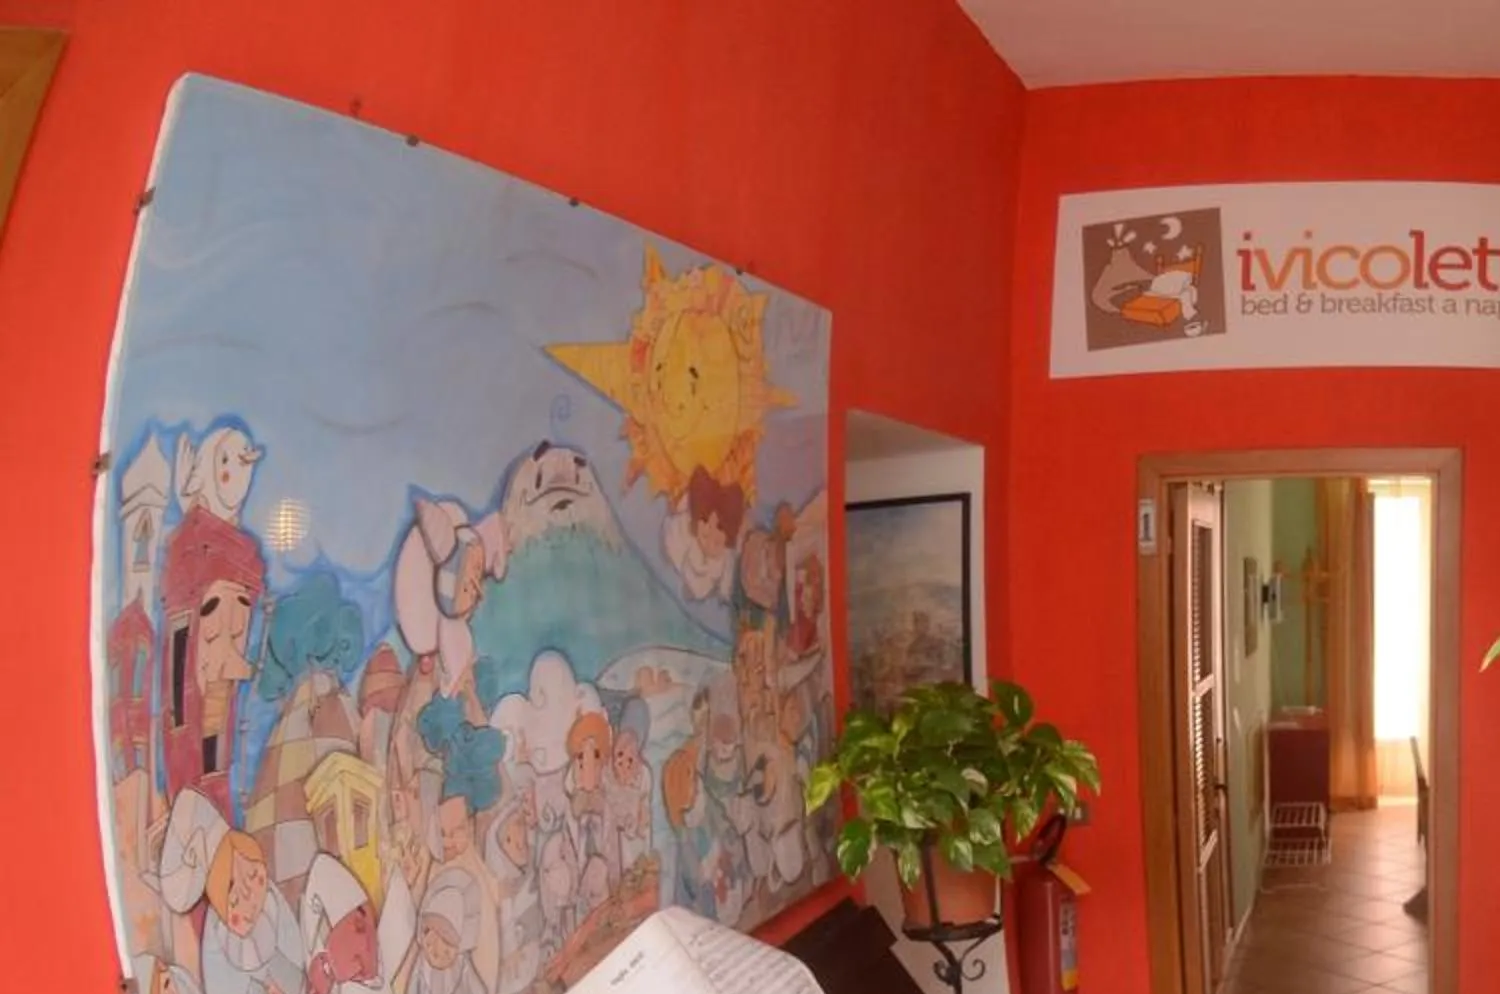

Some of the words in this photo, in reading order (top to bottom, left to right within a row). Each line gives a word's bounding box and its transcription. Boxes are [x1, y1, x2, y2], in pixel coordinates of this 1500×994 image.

[1240, 294, 1289, 316] bed
[1295, 294, 1314, 314] &
[1320, 293, 1436, 314] breakfast
[1441, 299, 1458, 315] a
